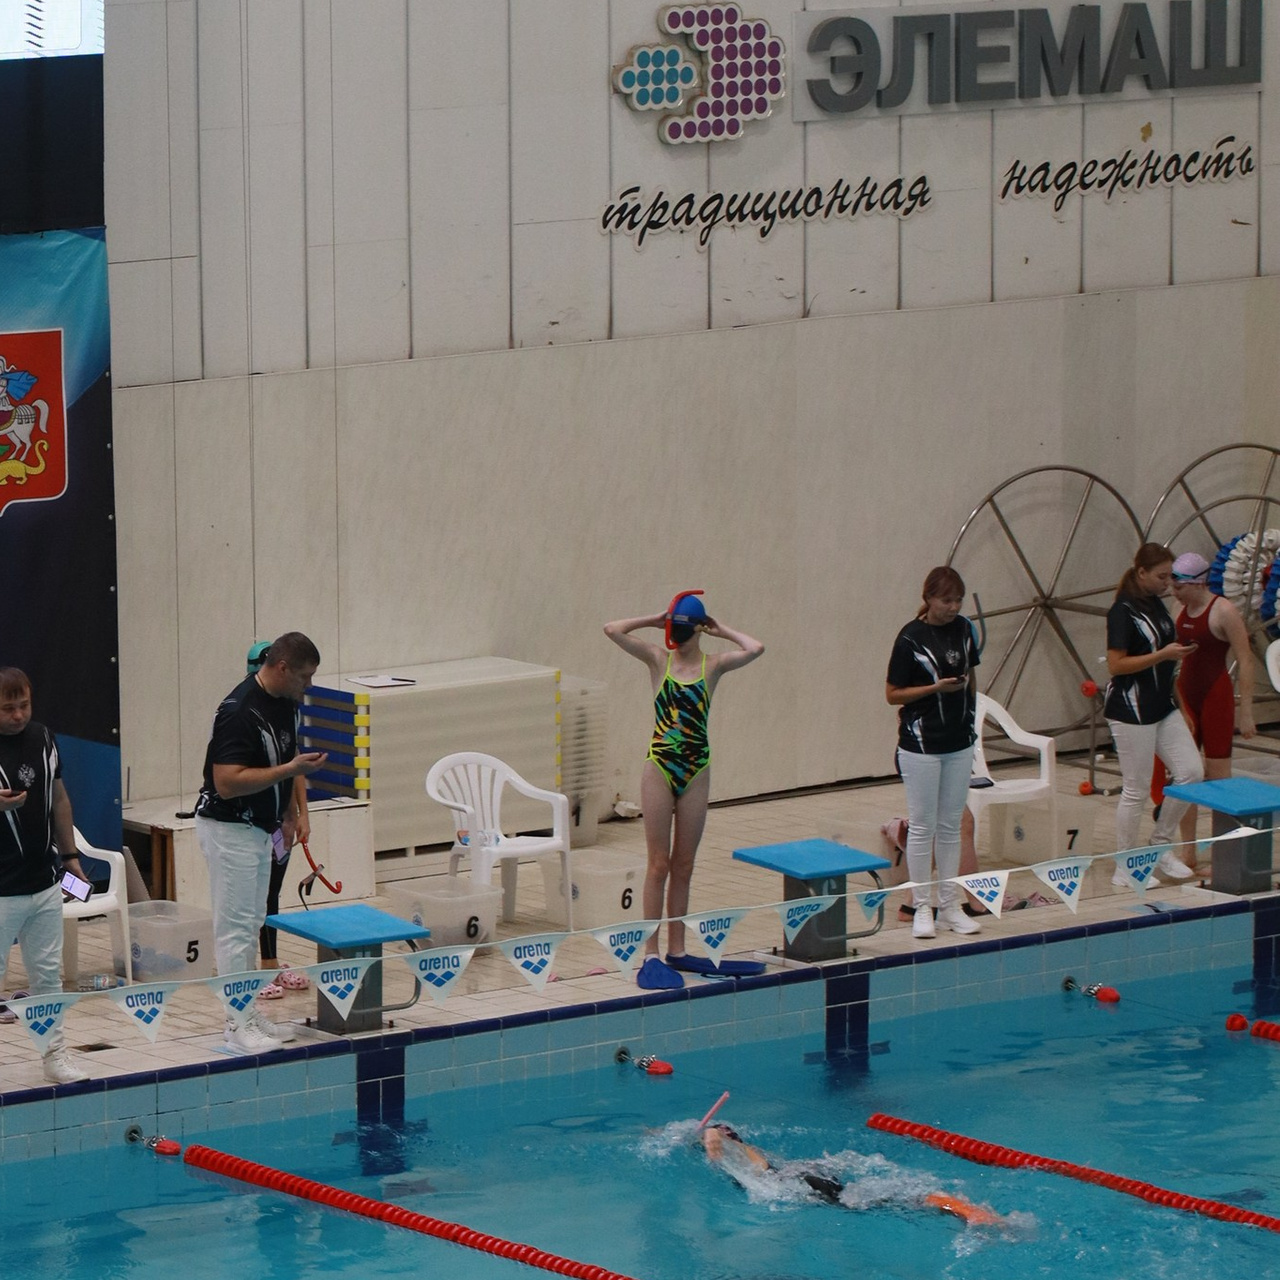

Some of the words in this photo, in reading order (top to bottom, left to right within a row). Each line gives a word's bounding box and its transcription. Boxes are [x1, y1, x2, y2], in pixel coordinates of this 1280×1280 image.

[602, 174, 932, 245] традиционная
[1000, 136, 1255, 212] надежность
[1066, 829, 1079, 850] 7
[1127, 852, 1158, 869] arena
[1048, 865, 1080, 882] arena
[966, 876, 1001, 889] arena
[621, 888, 633, 910] 6
[786, 903, 821, 920] arena
[466, 915, 479, 938] 6
[699, 917, 732, 934] arena
[609, 930, 643, 947] arena
[186, 940, 199, 963] 5
[513, 942, 551, 959] arena
[419, 955, 461, 972] arena
[321, 967, 359, 984] arena
[224, 979, 261, 997] arena
[125, 991, 164, 1008] arena
[26, 1002, 63, 1020] arena
